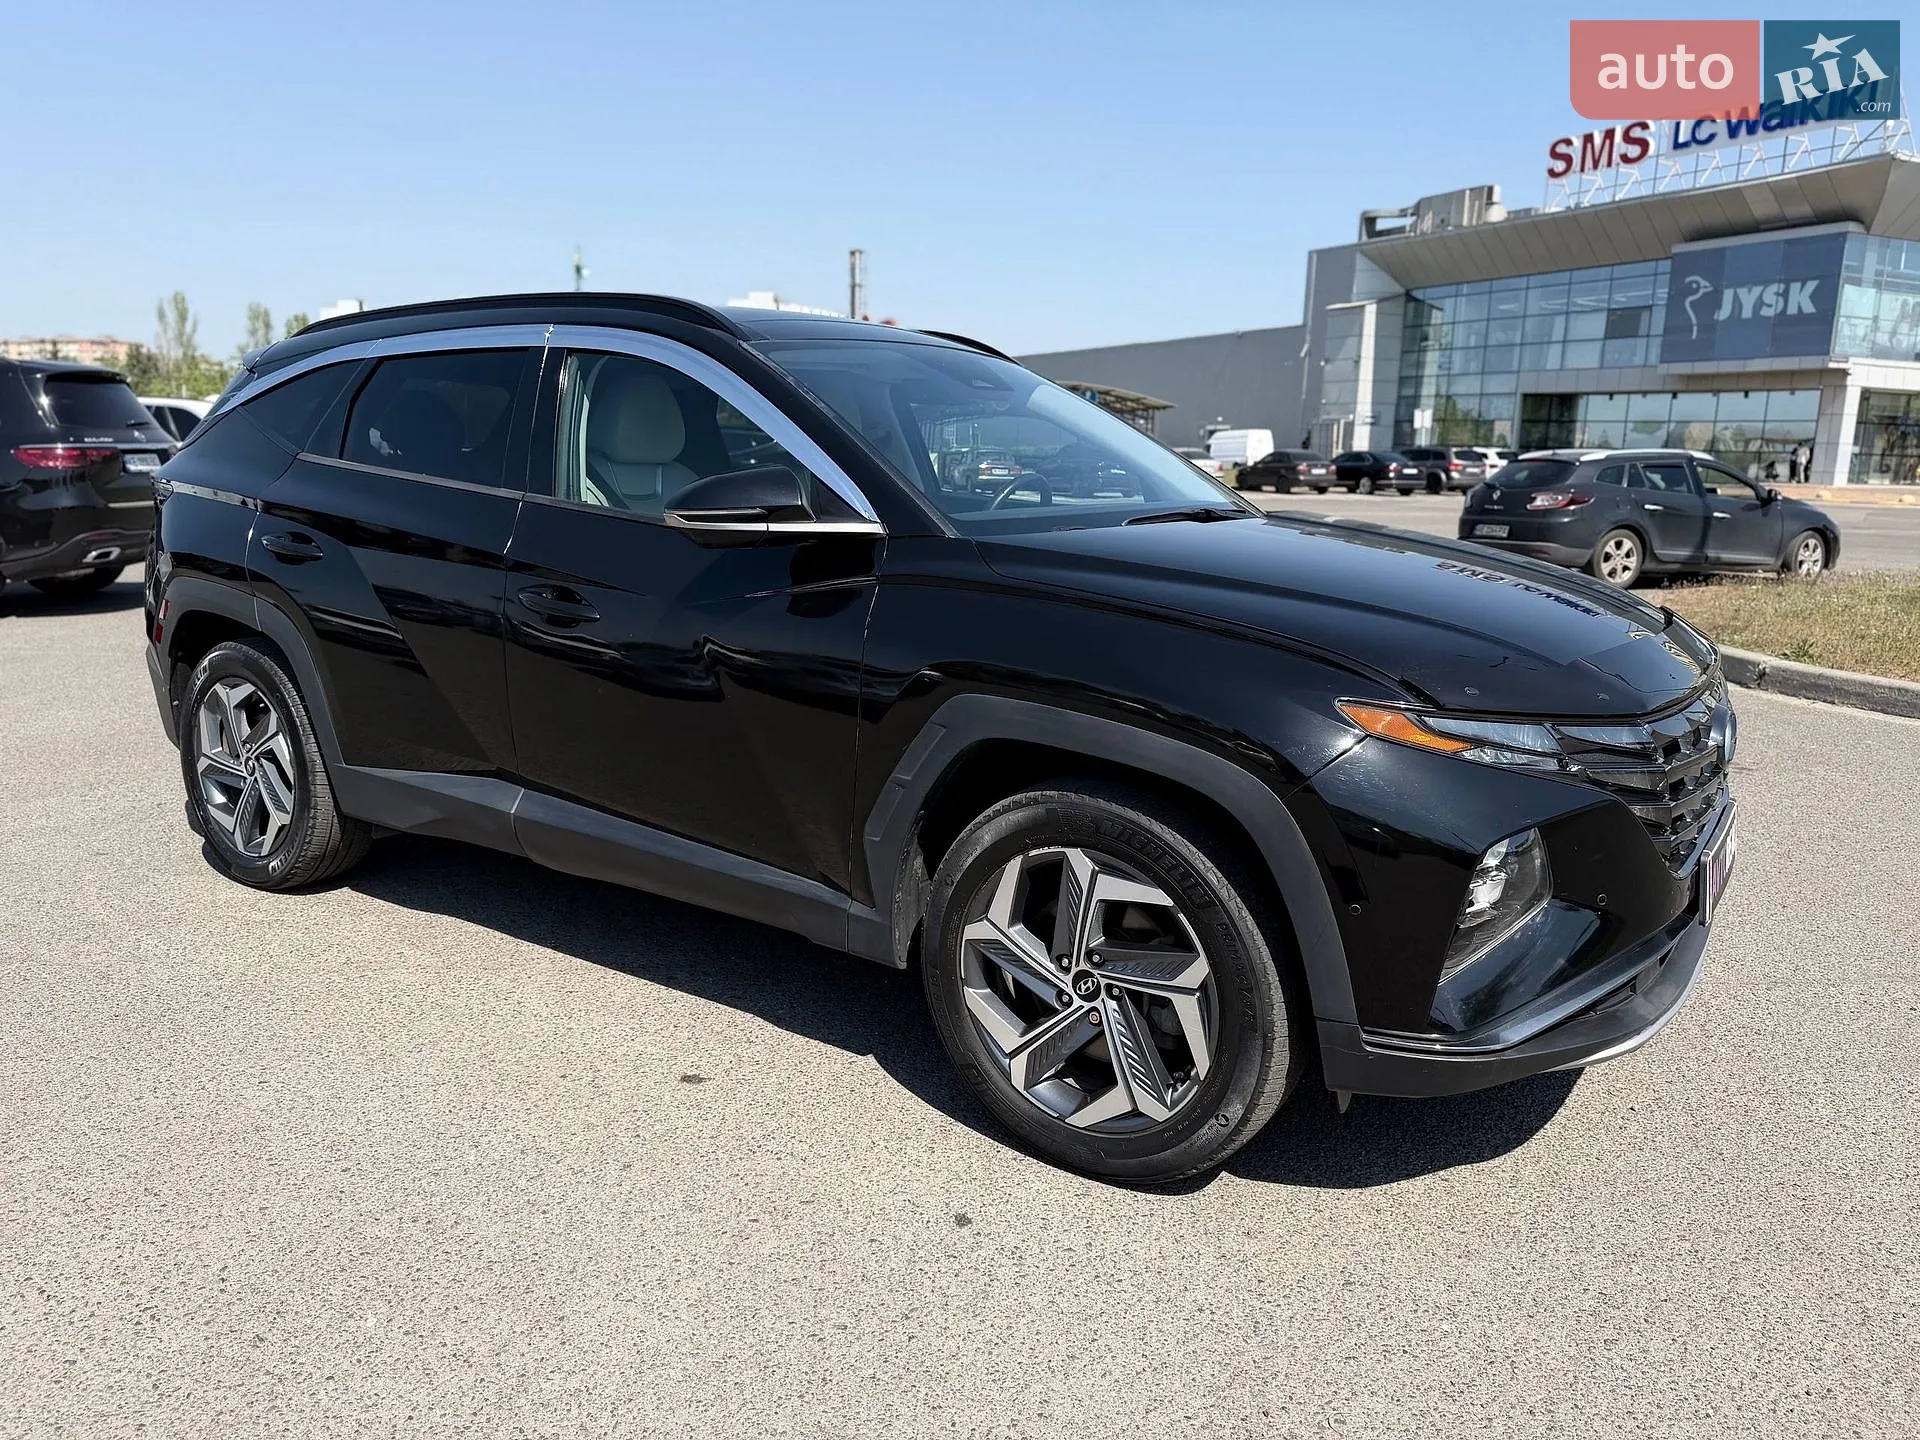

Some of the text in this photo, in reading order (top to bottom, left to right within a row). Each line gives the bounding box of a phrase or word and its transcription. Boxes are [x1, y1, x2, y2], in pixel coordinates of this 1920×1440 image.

[1547, 121, 1651, 179] SMS
[1673, 114, 1718, 150] LC
[1713, 279, 1821, 321] JYSK
